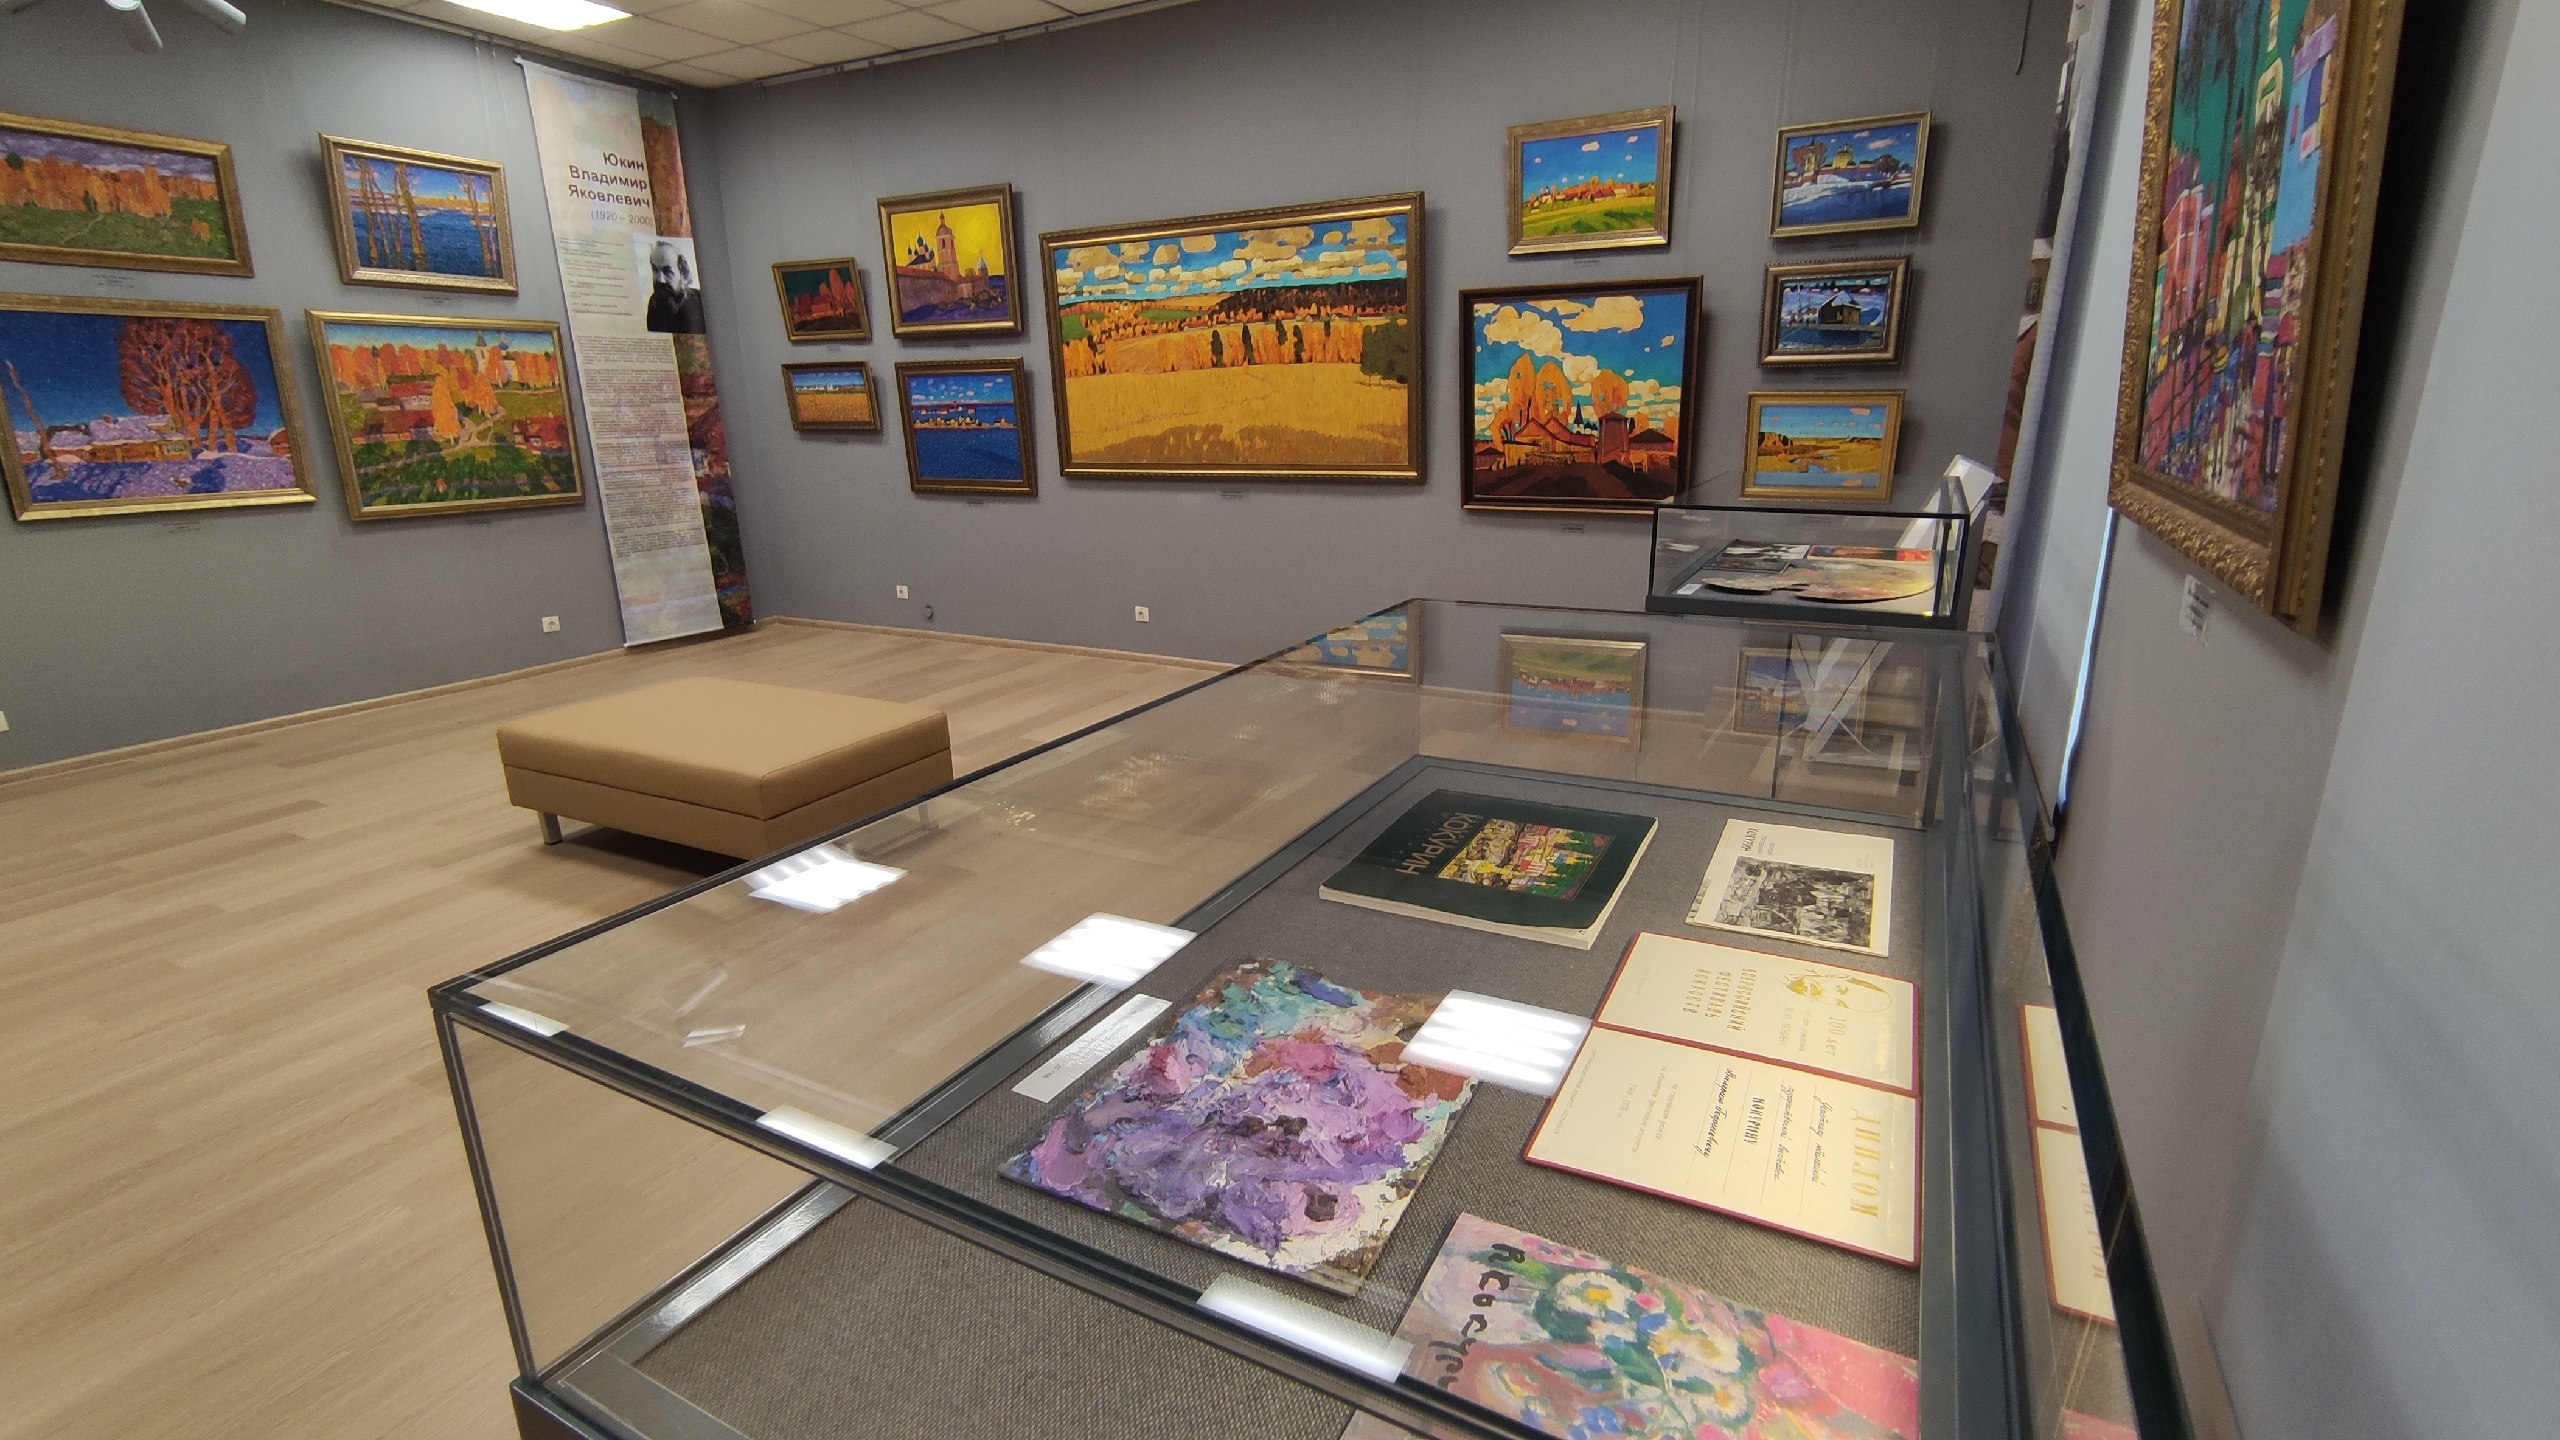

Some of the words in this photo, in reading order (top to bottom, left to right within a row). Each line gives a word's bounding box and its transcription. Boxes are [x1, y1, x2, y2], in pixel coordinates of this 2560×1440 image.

[569, 165, 648, 192] Владимир
[603, 152, 645, 171] Юкин
[569, 184, 650, 208] Яковлевич
[591, 209, 618, 222] (1920
[628, 214, 653, 228] 2000)
[1395, 812, 1483, 875] КОКУРИН
[1682, 968, 1711, 1014] ИСКУССТВ
[1704, 971, 1732, 1018] ФЕСТИВАЛЬ
[1727, 968, 1757, 1032] ВСЕРОССИЙСКИЙ
[1828, 1016, 1847, 1036] 100
[1850, 1109, 1881, 1217] ДИПЛОМ
